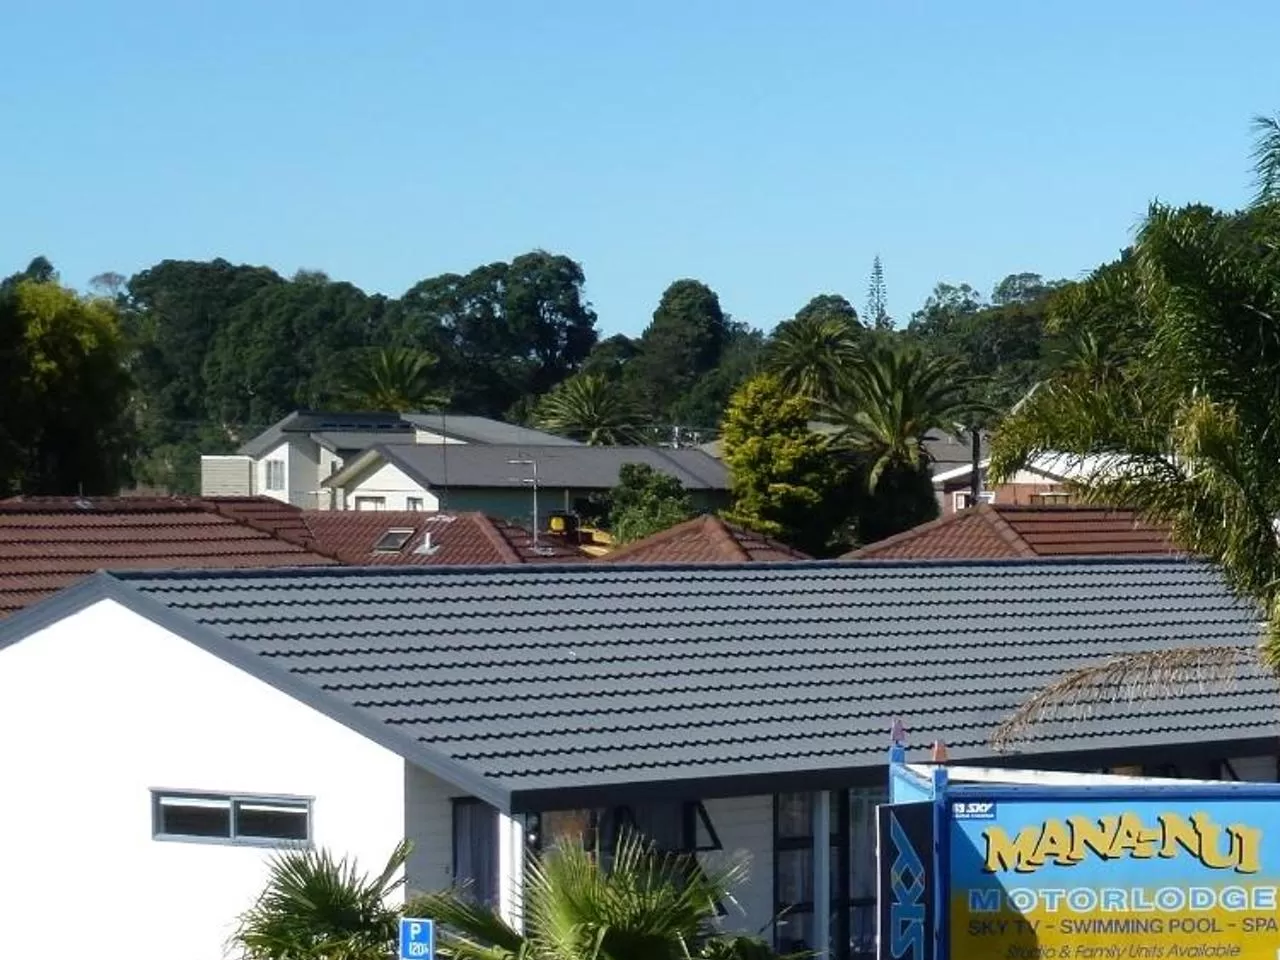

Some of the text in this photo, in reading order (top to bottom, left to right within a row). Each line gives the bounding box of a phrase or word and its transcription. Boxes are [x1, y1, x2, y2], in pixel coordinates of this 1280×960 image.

[981, 811, 1261, 874] MANA-NUI
[968, 886, 1278, 913] MOTORLODGE
[410, 923, 421, 940] P
[968, 920, 1009, 936] SKY
[1013, 920, 1040, 935] TV
[1060, 919, 1163, 934] SWIMMING
[1168, 918, 1221, 933] POOL
[1242, 917, 1278, 932] SPA
[1074, 944, 1127, 960] Family
[1128, 943, 1163, 958] Units
[1165, 943, 1240, 958] Available
